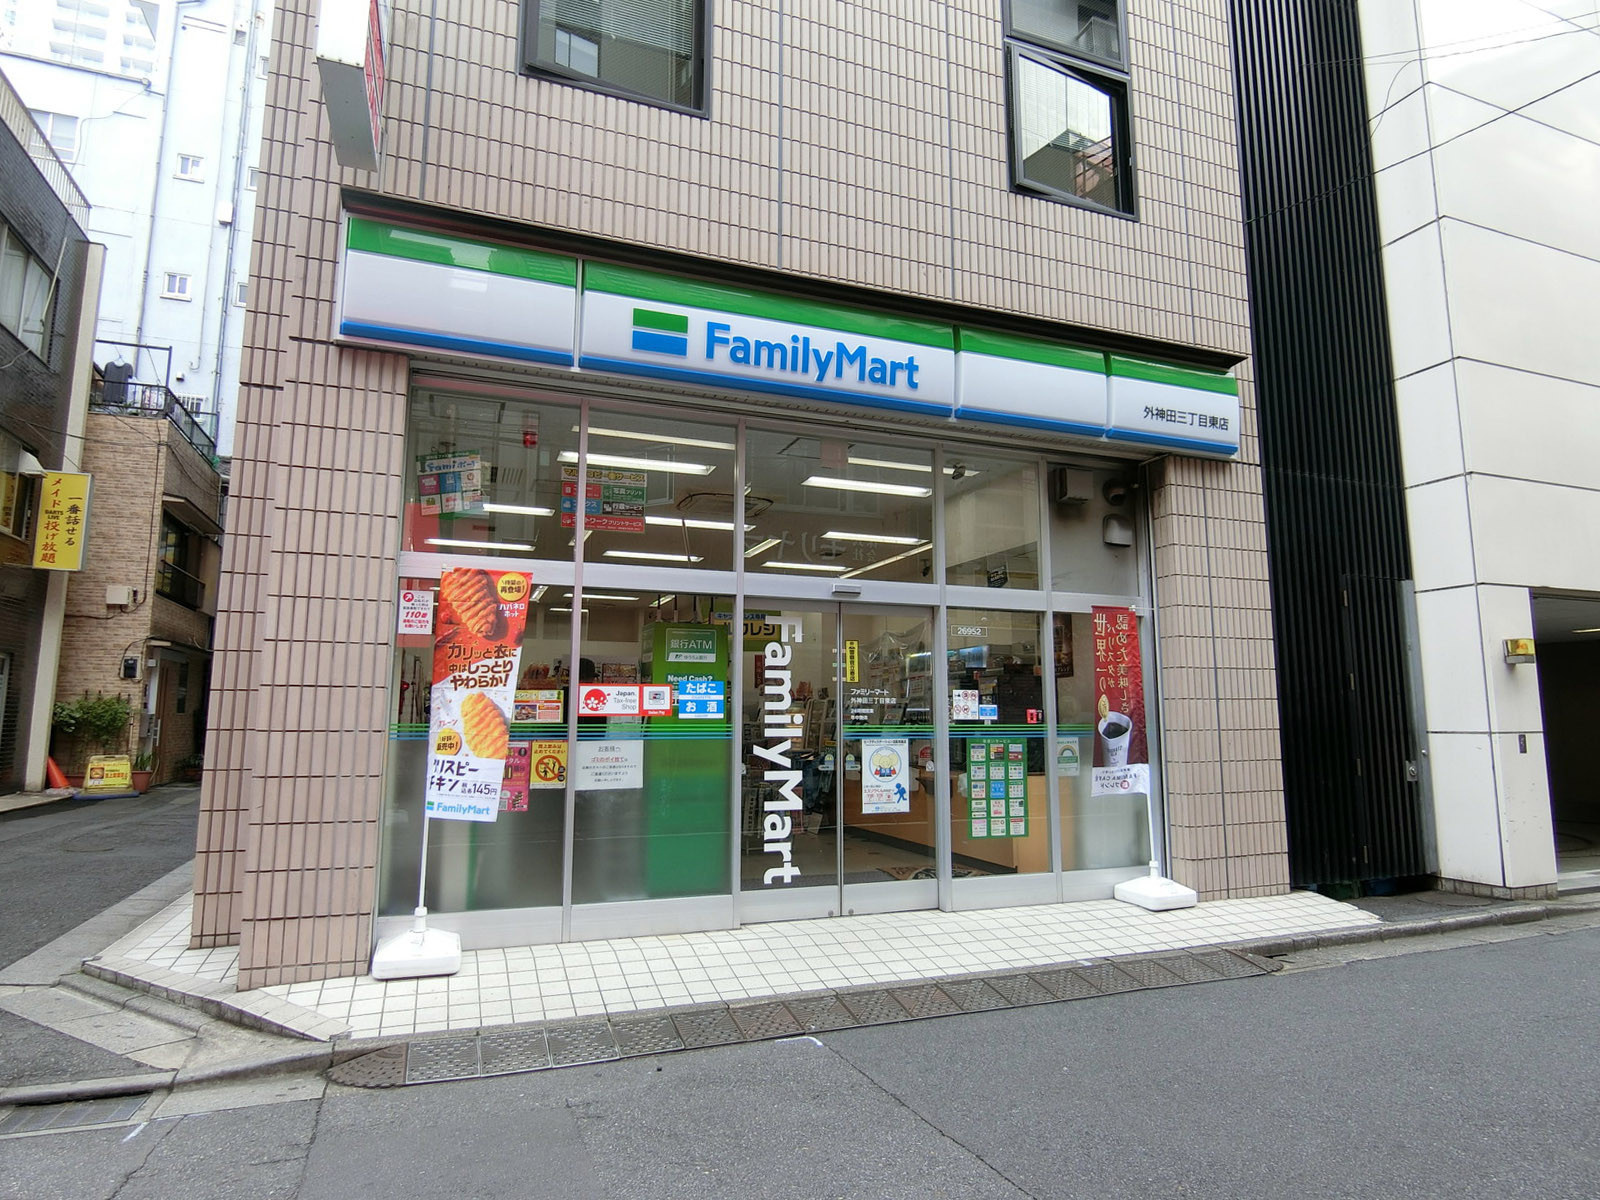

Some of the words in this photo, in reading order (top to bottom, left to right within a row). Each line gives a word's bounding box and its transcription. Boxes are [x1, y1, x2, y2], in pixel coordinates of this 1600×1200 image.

[705, 321, 919, 389] FamilyMart
[1143, 405, 1229, 431] 外神田三丁目東店
[51, 478, 62, 508] メイド
[65, 496, 83, 546] 一番話せる
[40, 520, 60, 564] 投げ放題
[957, 627, 982, 636] 26952
[447, 642, 517, 660] カリッと衣に
[670, 639, 713, 649] 銀行ATM
[449, 660, 513, 675] 中はしっとり
[685, 682, 717, 694] たばこ
[850, 688, 889, 696] ファミリーマート
[850, 697, 897, 705] 外神田三丁目東店
[753, 615, 803, 884] FamilyMart
[436, 802, 490, 815] FamilyMart
